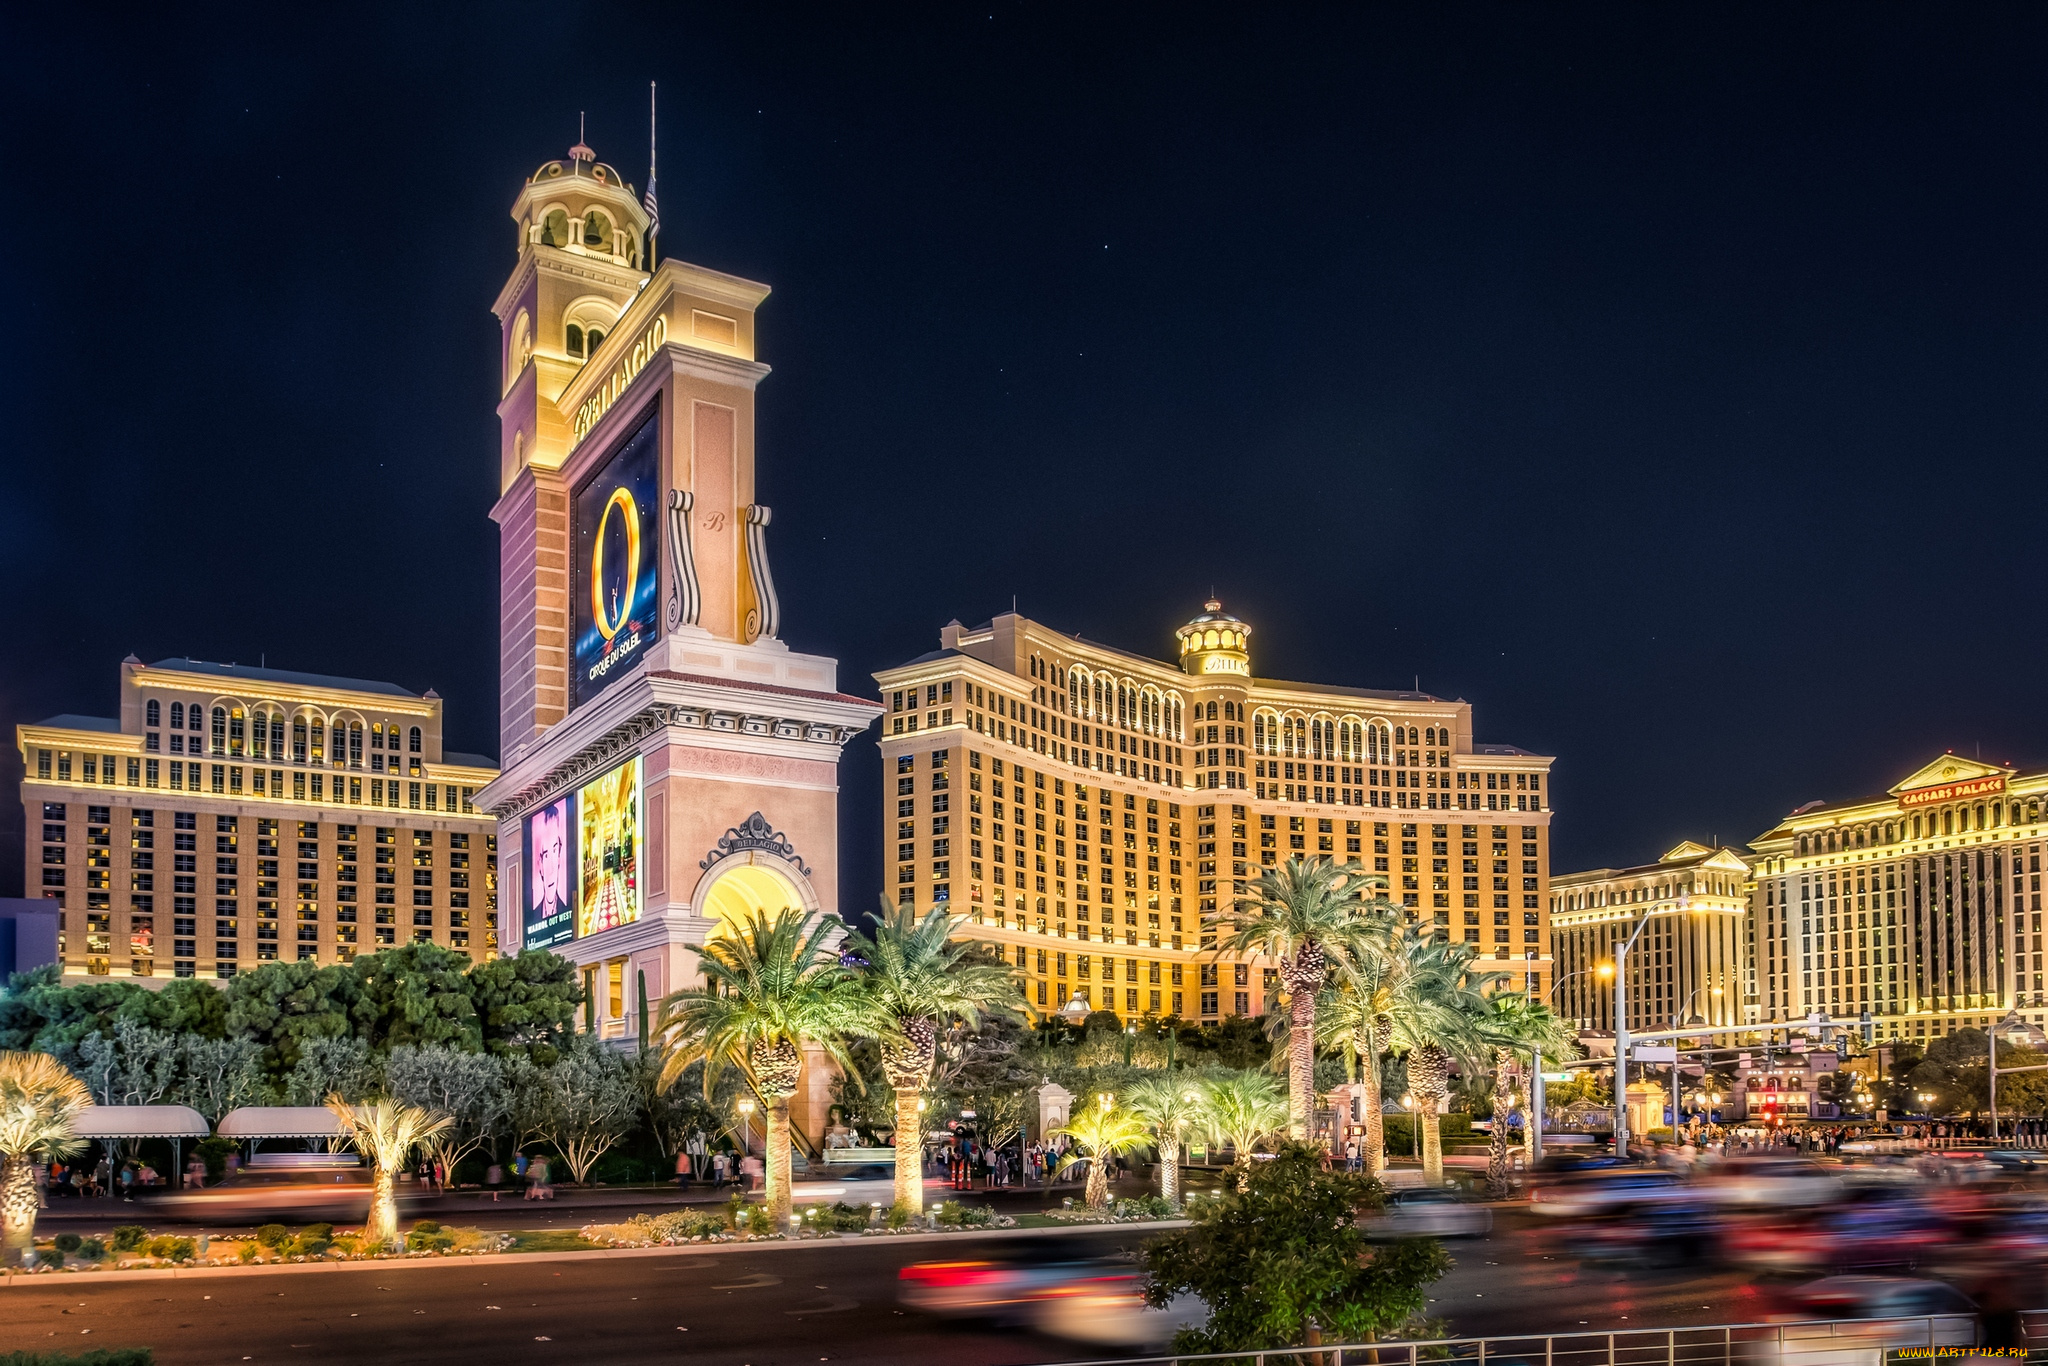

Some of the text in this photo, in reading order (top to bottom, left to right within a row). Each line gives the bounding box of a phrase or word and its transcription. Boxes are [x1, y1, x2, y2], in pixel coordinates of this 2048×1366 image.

[572, 313, 667, 444] BELLAGIO
[592, 487, 641, 641] O
[589, 632, 642, 681] CIRQUE DU SOLEIL
[1903, 779, 2002, 804] CAESARS PALACE
[737, 839, 780, 851] BELLAGIO
[548, 915, 559, 927] OUT
[558, 910, 573, 923] WEST
